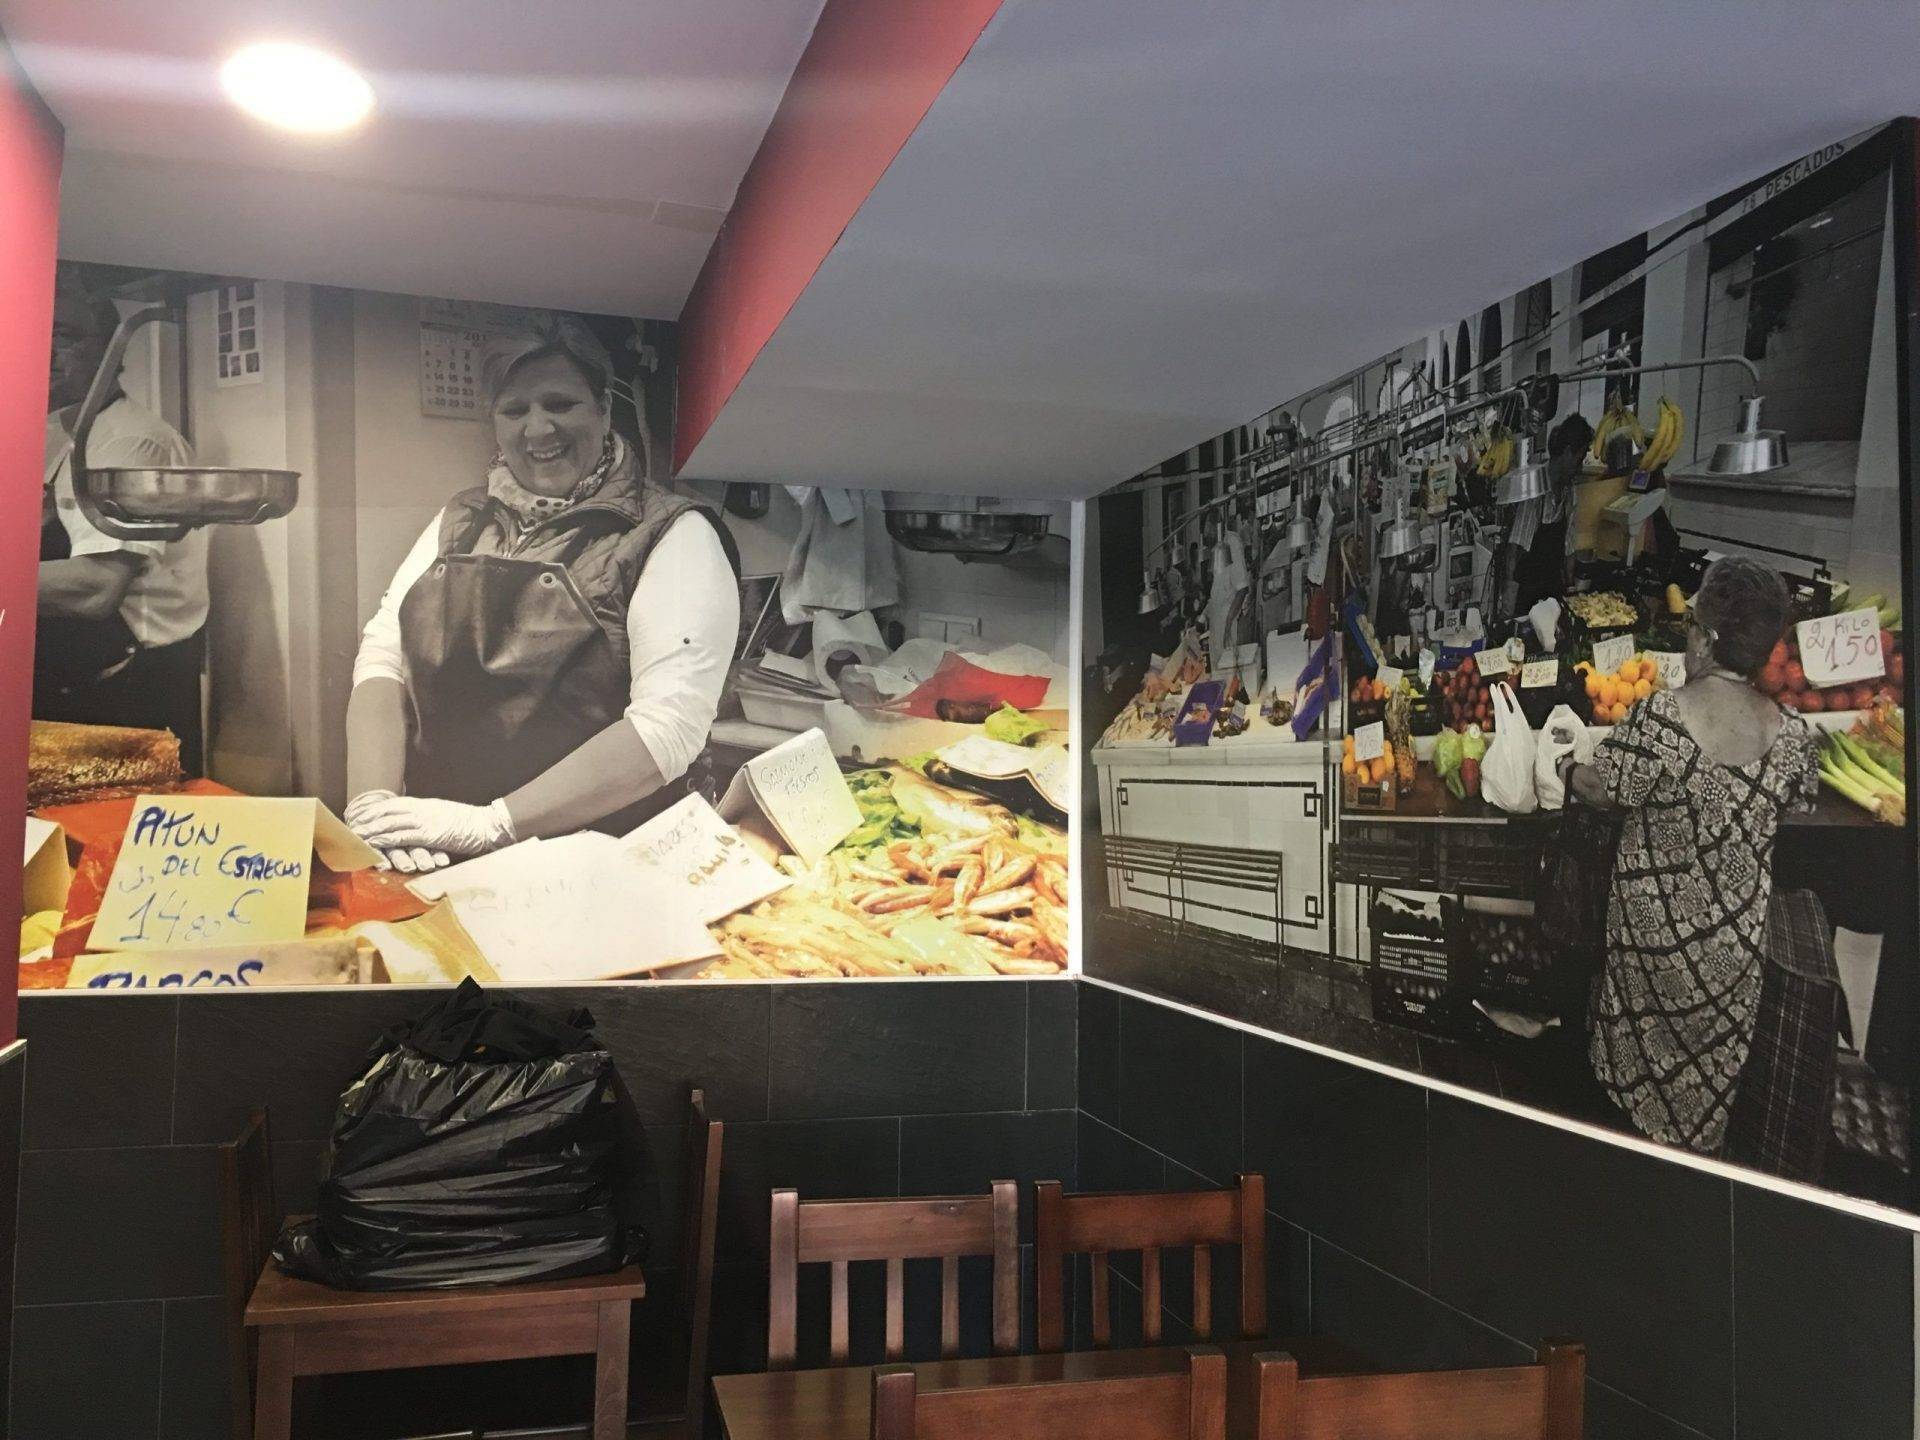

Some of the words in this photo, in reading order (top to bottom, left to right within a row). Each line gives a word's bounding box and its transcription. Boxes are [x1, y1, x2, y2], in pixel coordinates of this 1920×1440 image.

[1765, 142, 1846, 199] PESCADOS
[447, 386, 460, 395] 22
[462, 387, 474, 396] 23
[133, 806, 220, 847] ATUN
[161, 853, 201, 878] DEL
